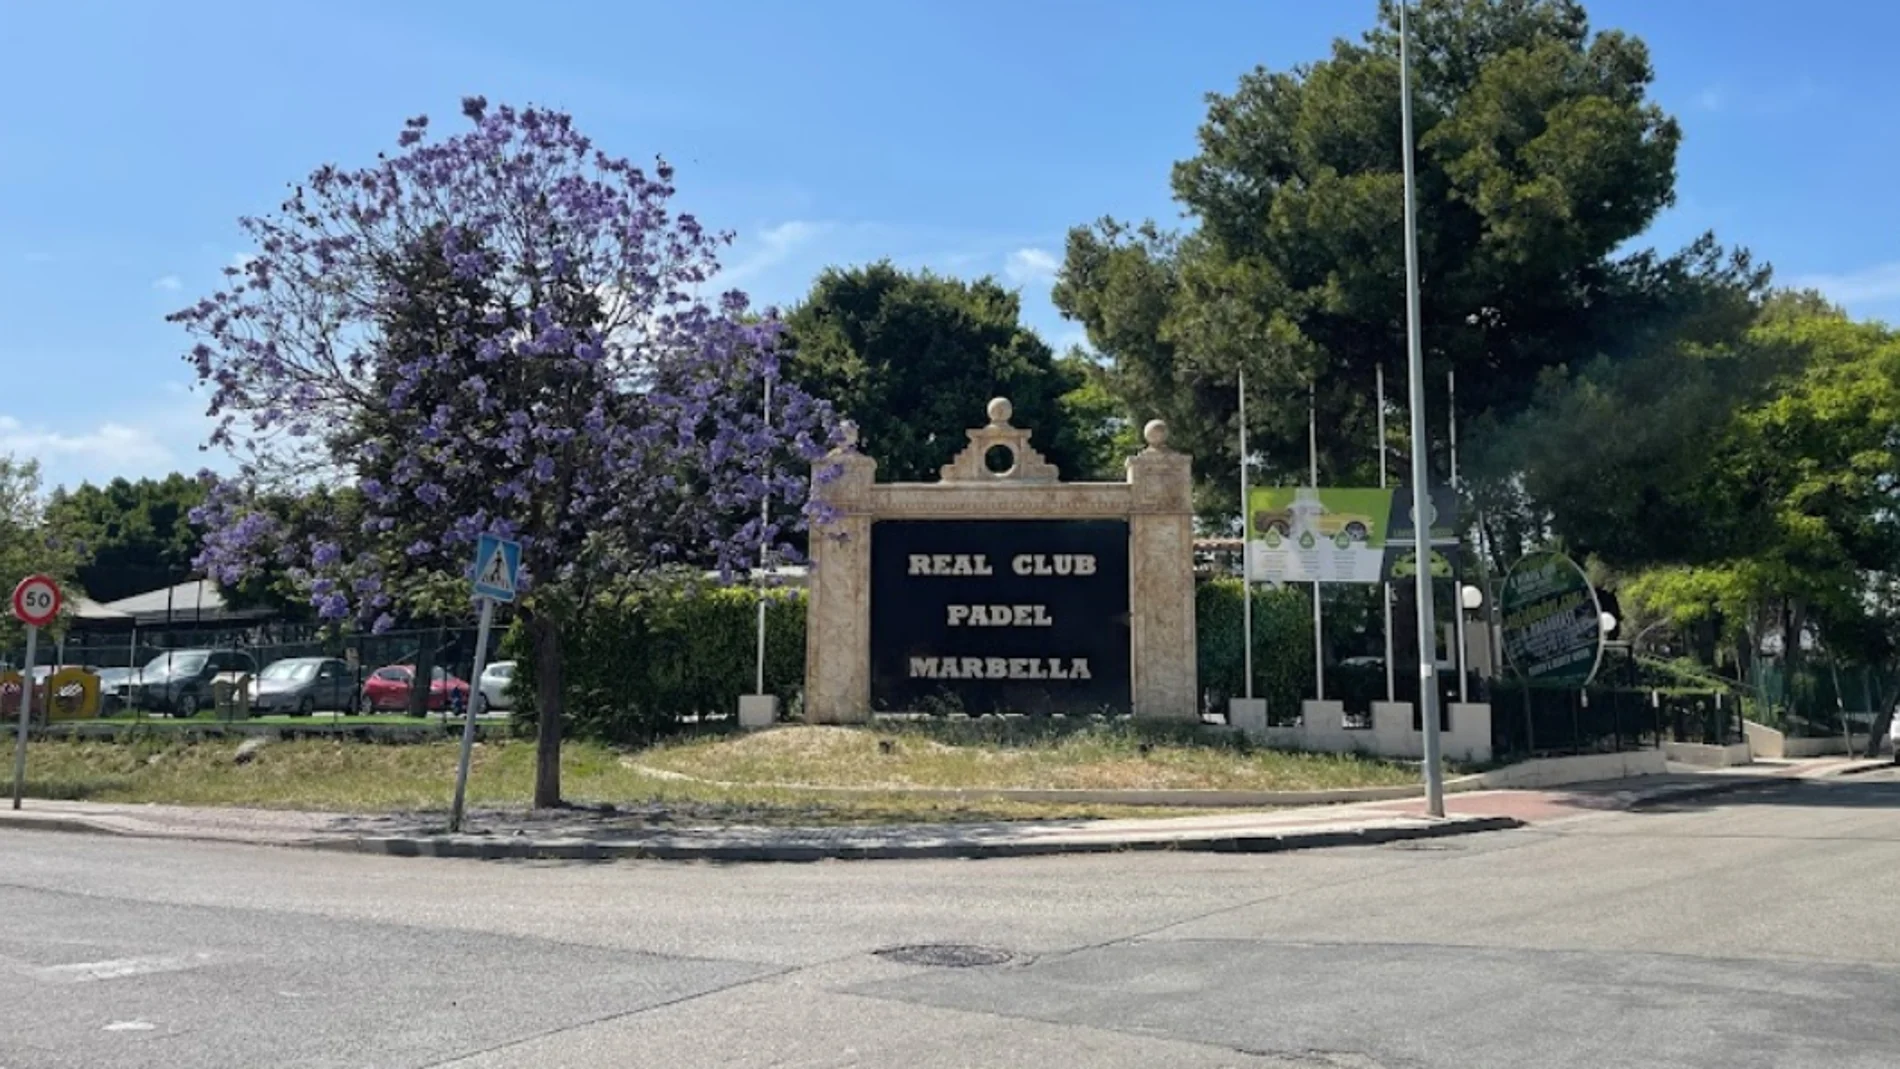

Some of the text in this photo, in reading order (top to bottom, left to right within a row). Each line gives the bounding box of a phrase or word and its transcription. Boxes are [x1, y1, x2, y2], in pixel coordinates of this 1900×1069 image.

[908, 554, 1097, 576] REAL CLUB
[26, 591, 51, 608] 50
[947, 605, 1052, 626] PADEL
[909, 657, 1091, 679] MARBELLA
